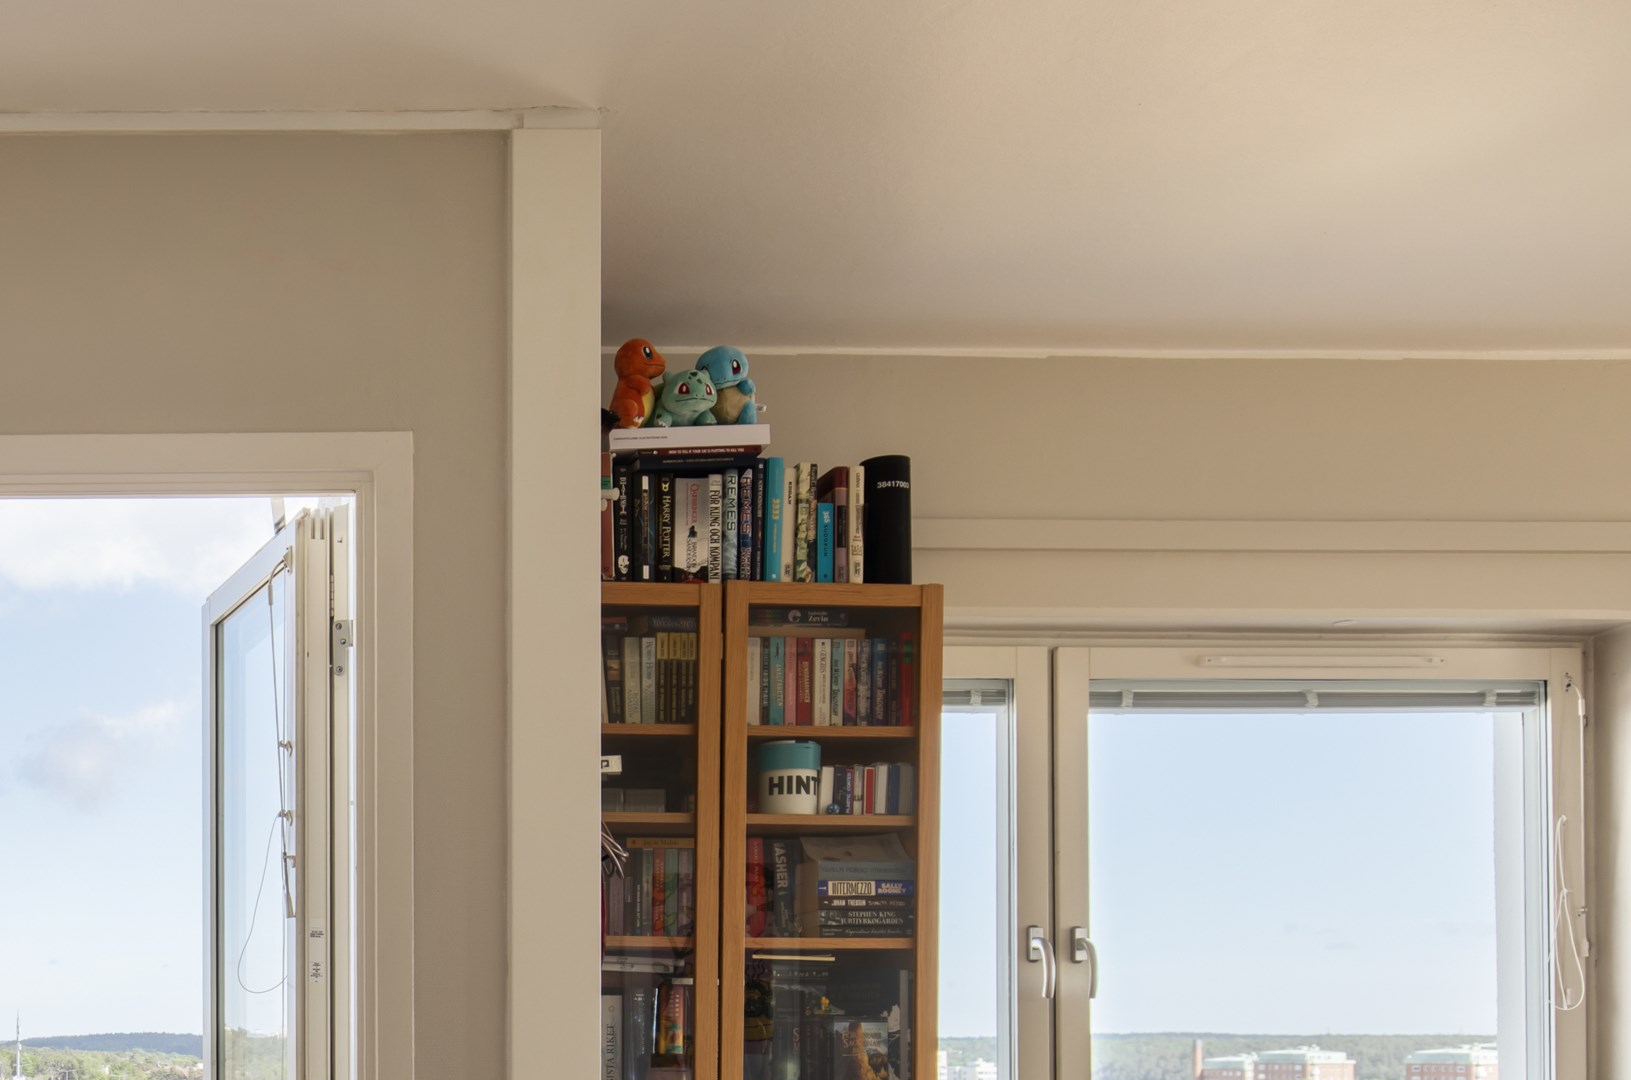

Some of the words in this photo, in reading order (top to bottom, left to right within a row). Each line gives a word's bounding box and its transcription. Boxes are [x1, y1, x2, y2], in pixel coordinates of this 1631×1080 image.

[663, 495, 671, 523] HARRY
[709, 490, 722, 505] FÖR
[726, 475, 737, 531] REMES
[740, 476, 752, 535] REMES
[709, 506, 721, 527] KUNG
[823, 511, 831, 524] 365
[663, 526, 671, 558] POTTER
[709, 528, 721, 544] OCH
[709, 546, 721, 580] KOMPANI
[774, 847, 789, 889] ASHER
[831, 882, 872, 895] INTERMEZZO
[606, 1023, 615, 1055] RIKET
